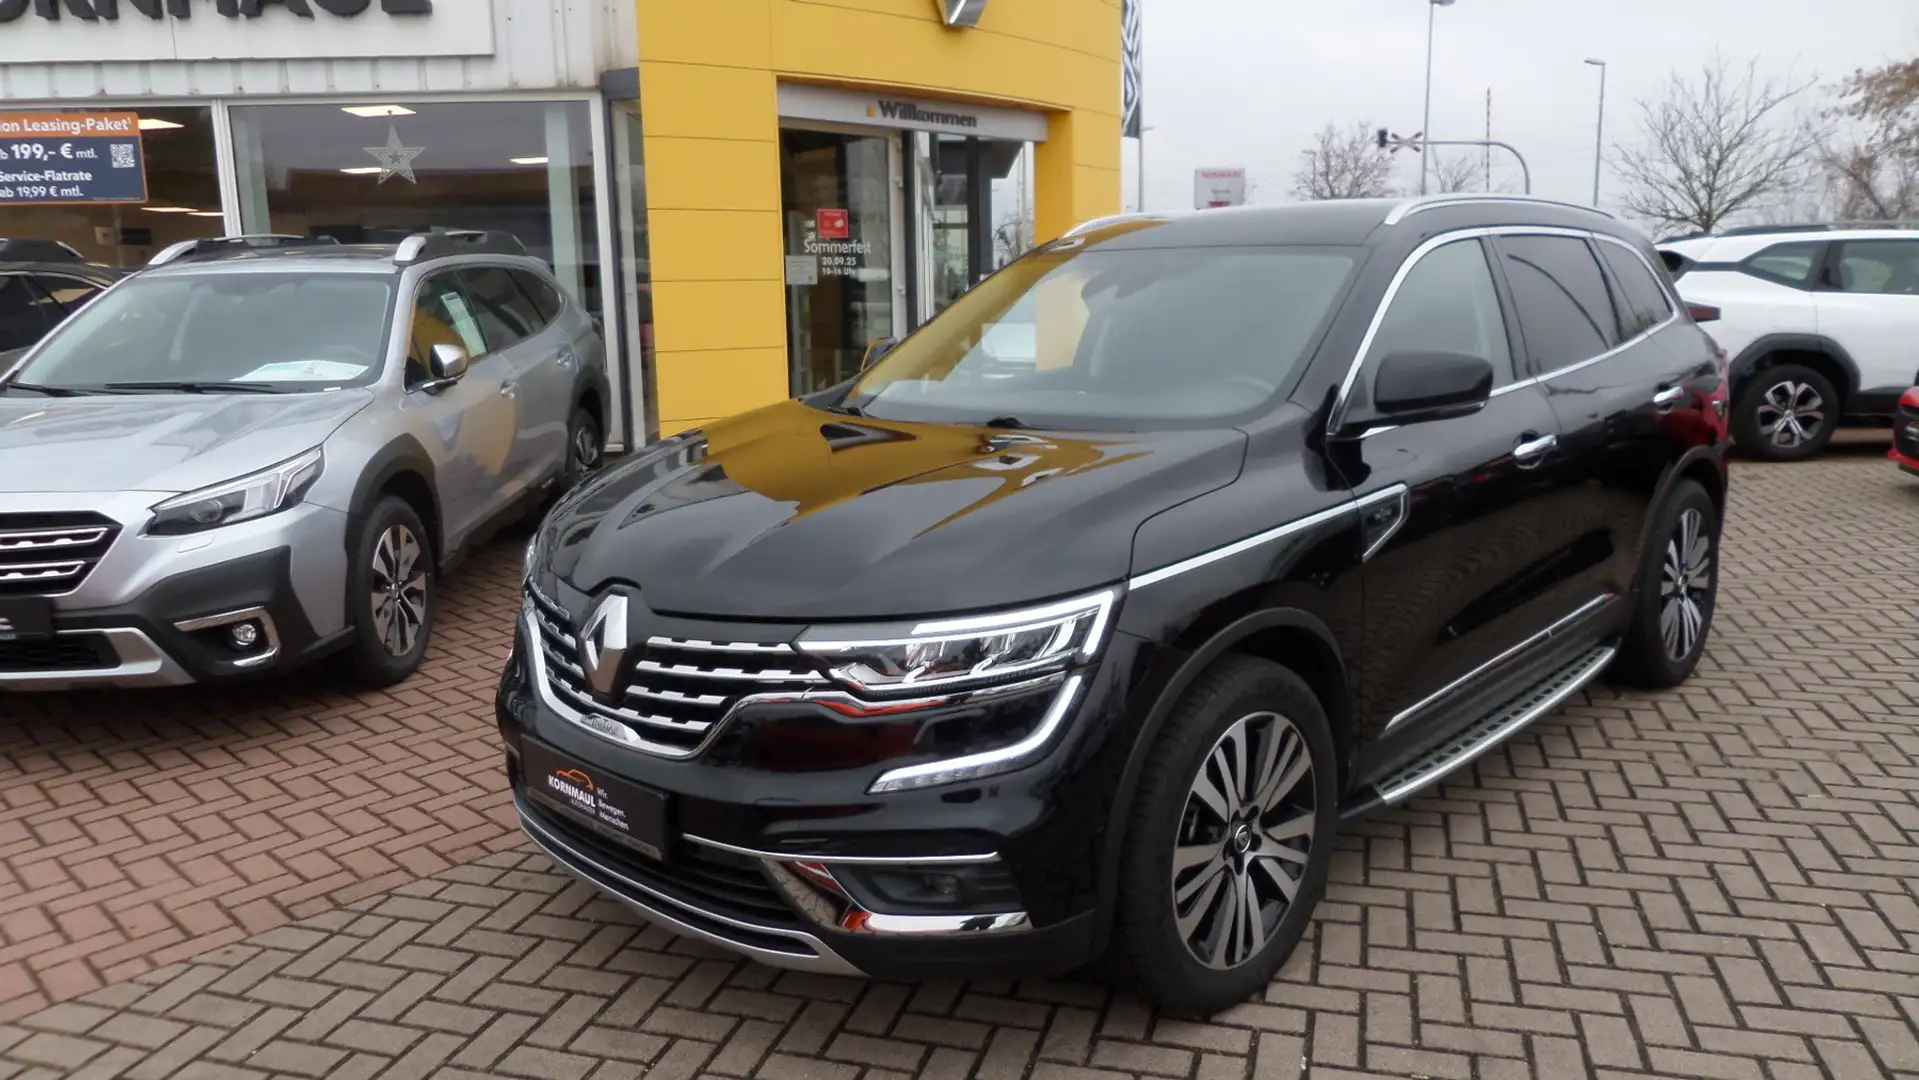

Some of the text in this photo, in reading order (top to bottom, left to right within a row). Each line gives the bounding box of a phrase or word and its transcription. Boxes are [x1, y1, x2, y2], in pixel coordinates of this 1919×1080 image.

[878, 100, 978, 128] Willkommen
[10, 143, 56, 161] 199,-
[60, 143, 73, 159] €
[75, 148, 98, 159] mtl.
[0, 170, 93, 182] Service-Flatrate
[16, 185, 47, 198] 19,99
[49, 185, 58, 198] €
[60, 184, 84, 197] mtl.
[803, 239, 872, 254] Sommerfest
[822, 256, 857, 266] 20.09.25
[548, 774, 596, 807] KORNMAUL
